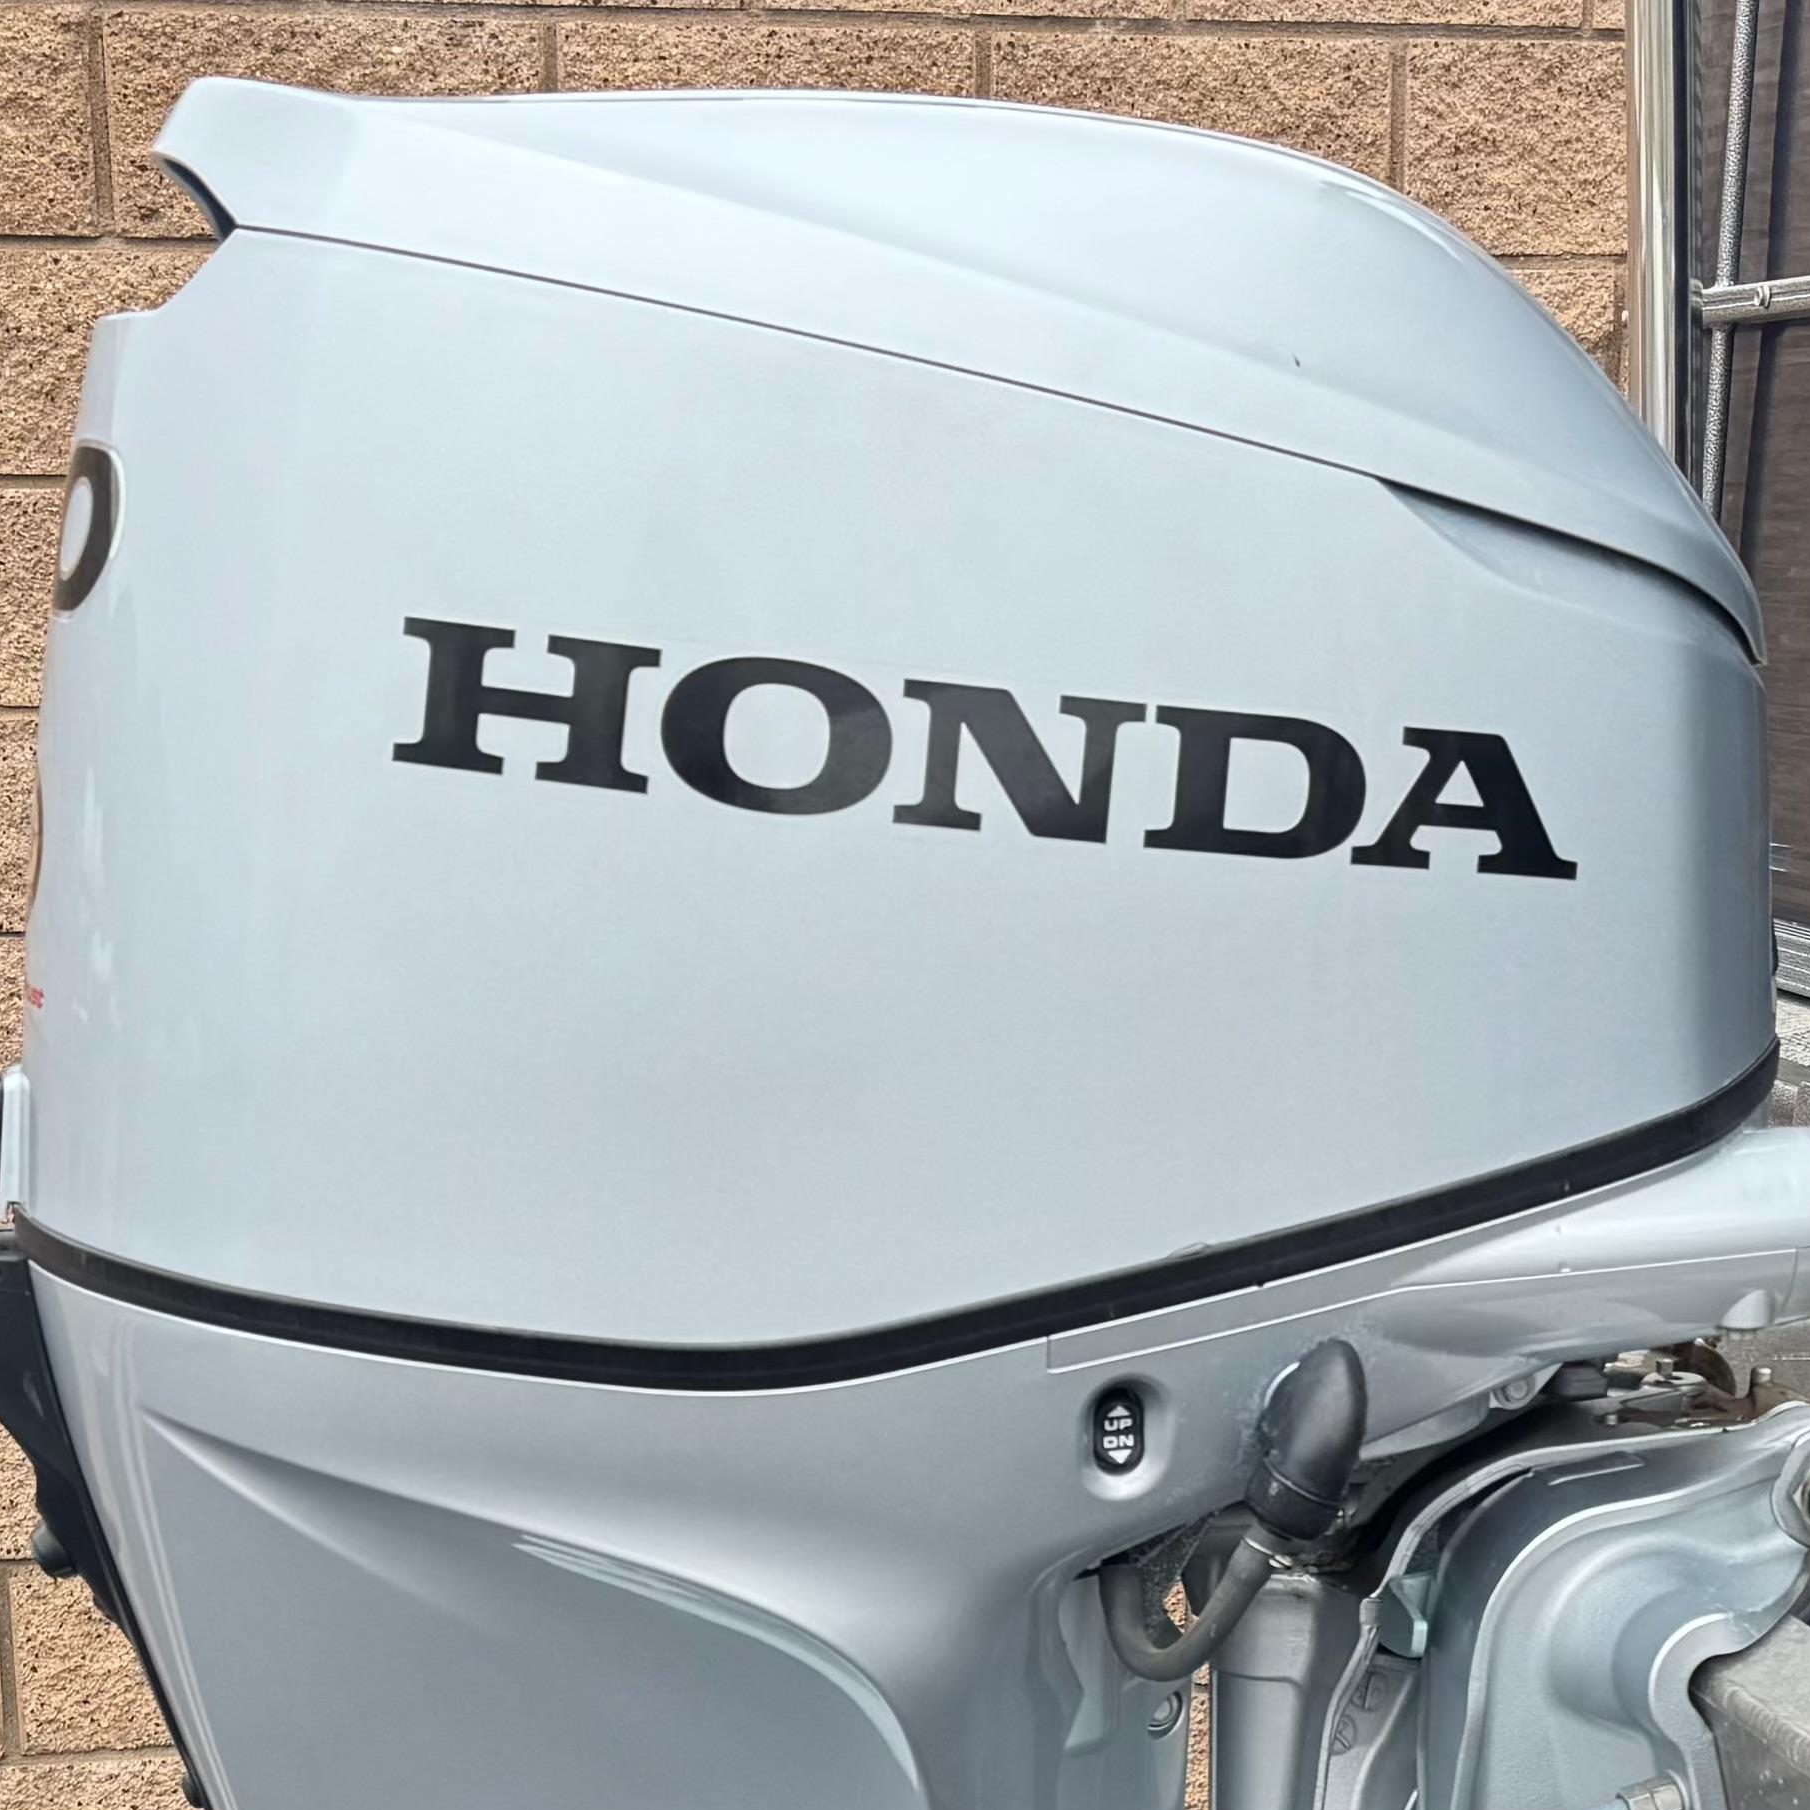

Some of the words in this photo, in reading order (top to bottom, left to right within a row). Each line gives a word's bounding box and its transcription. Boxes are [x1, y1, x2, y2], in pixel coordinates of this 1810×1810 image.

[392, 616, 1578, 881] HONDA
[1103, 1418, 1133, 1431] UP
[1102, 1434, 1135, 1449] DN
